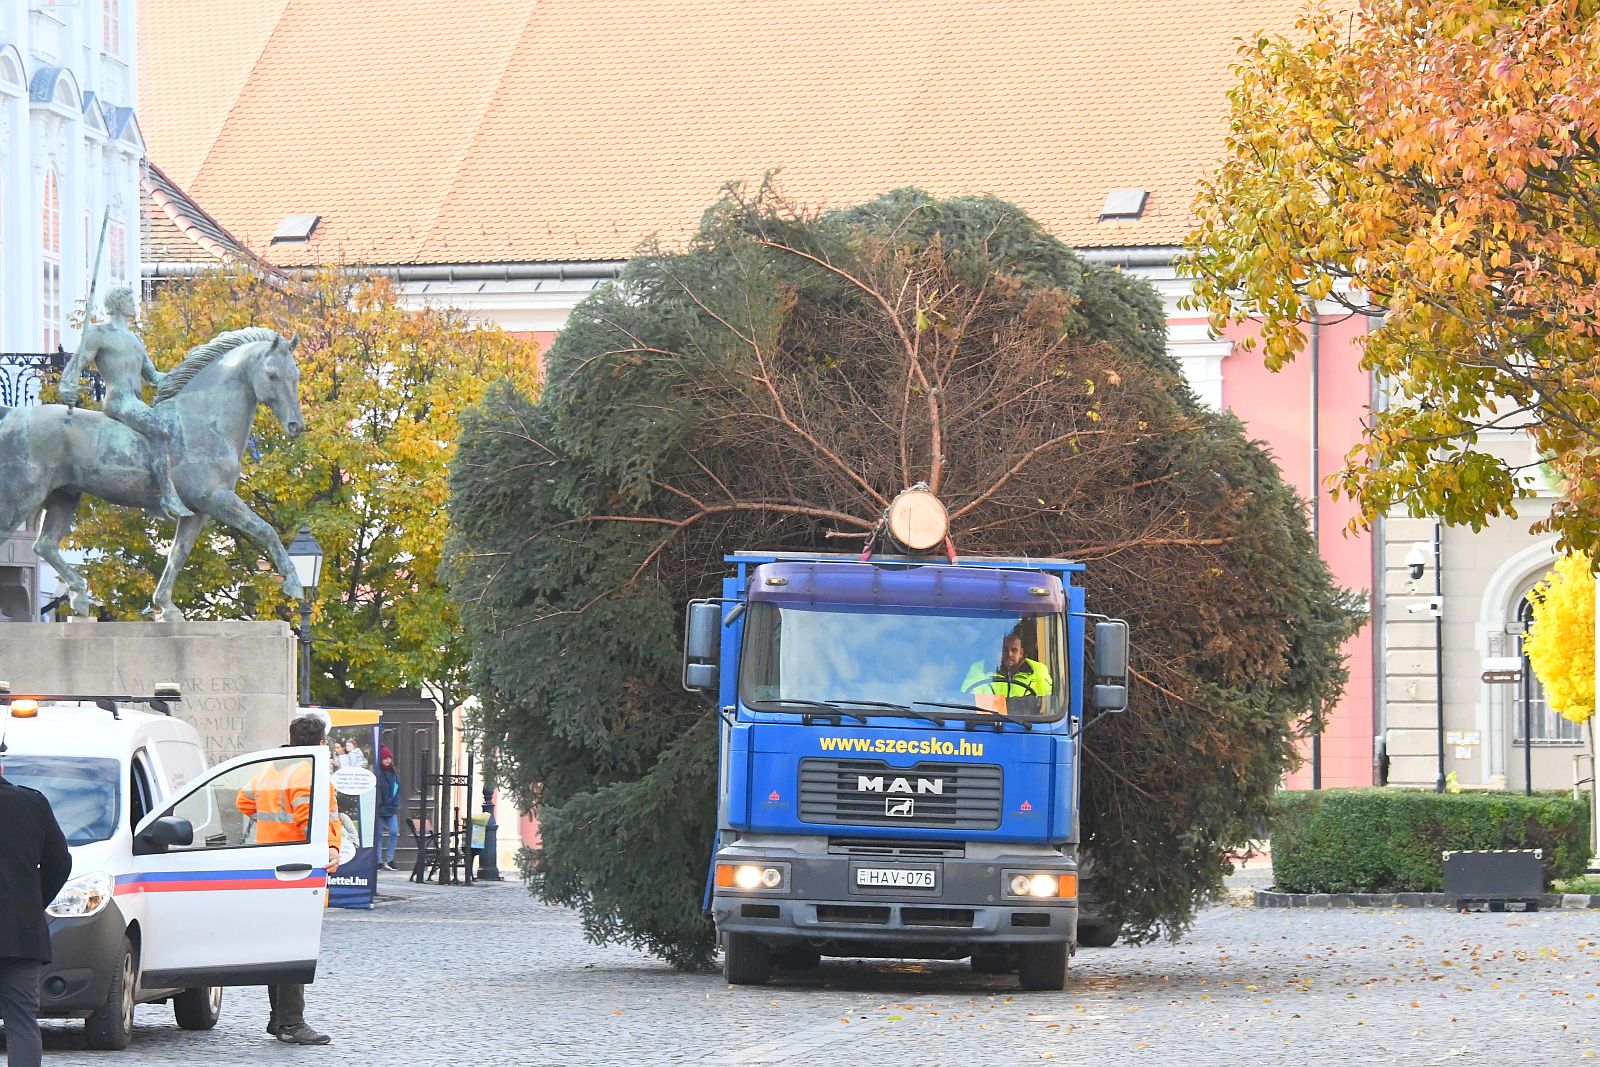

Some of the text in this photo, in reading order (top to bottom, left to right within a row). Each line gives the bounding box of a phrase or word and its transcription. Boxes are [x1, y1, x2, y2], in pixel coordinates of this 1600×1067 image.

[820, 737, 983, 756] www.szecsko.hu
[858, 776, 943, 795] MAN
[869, 871, 932, 885] HAV-076
